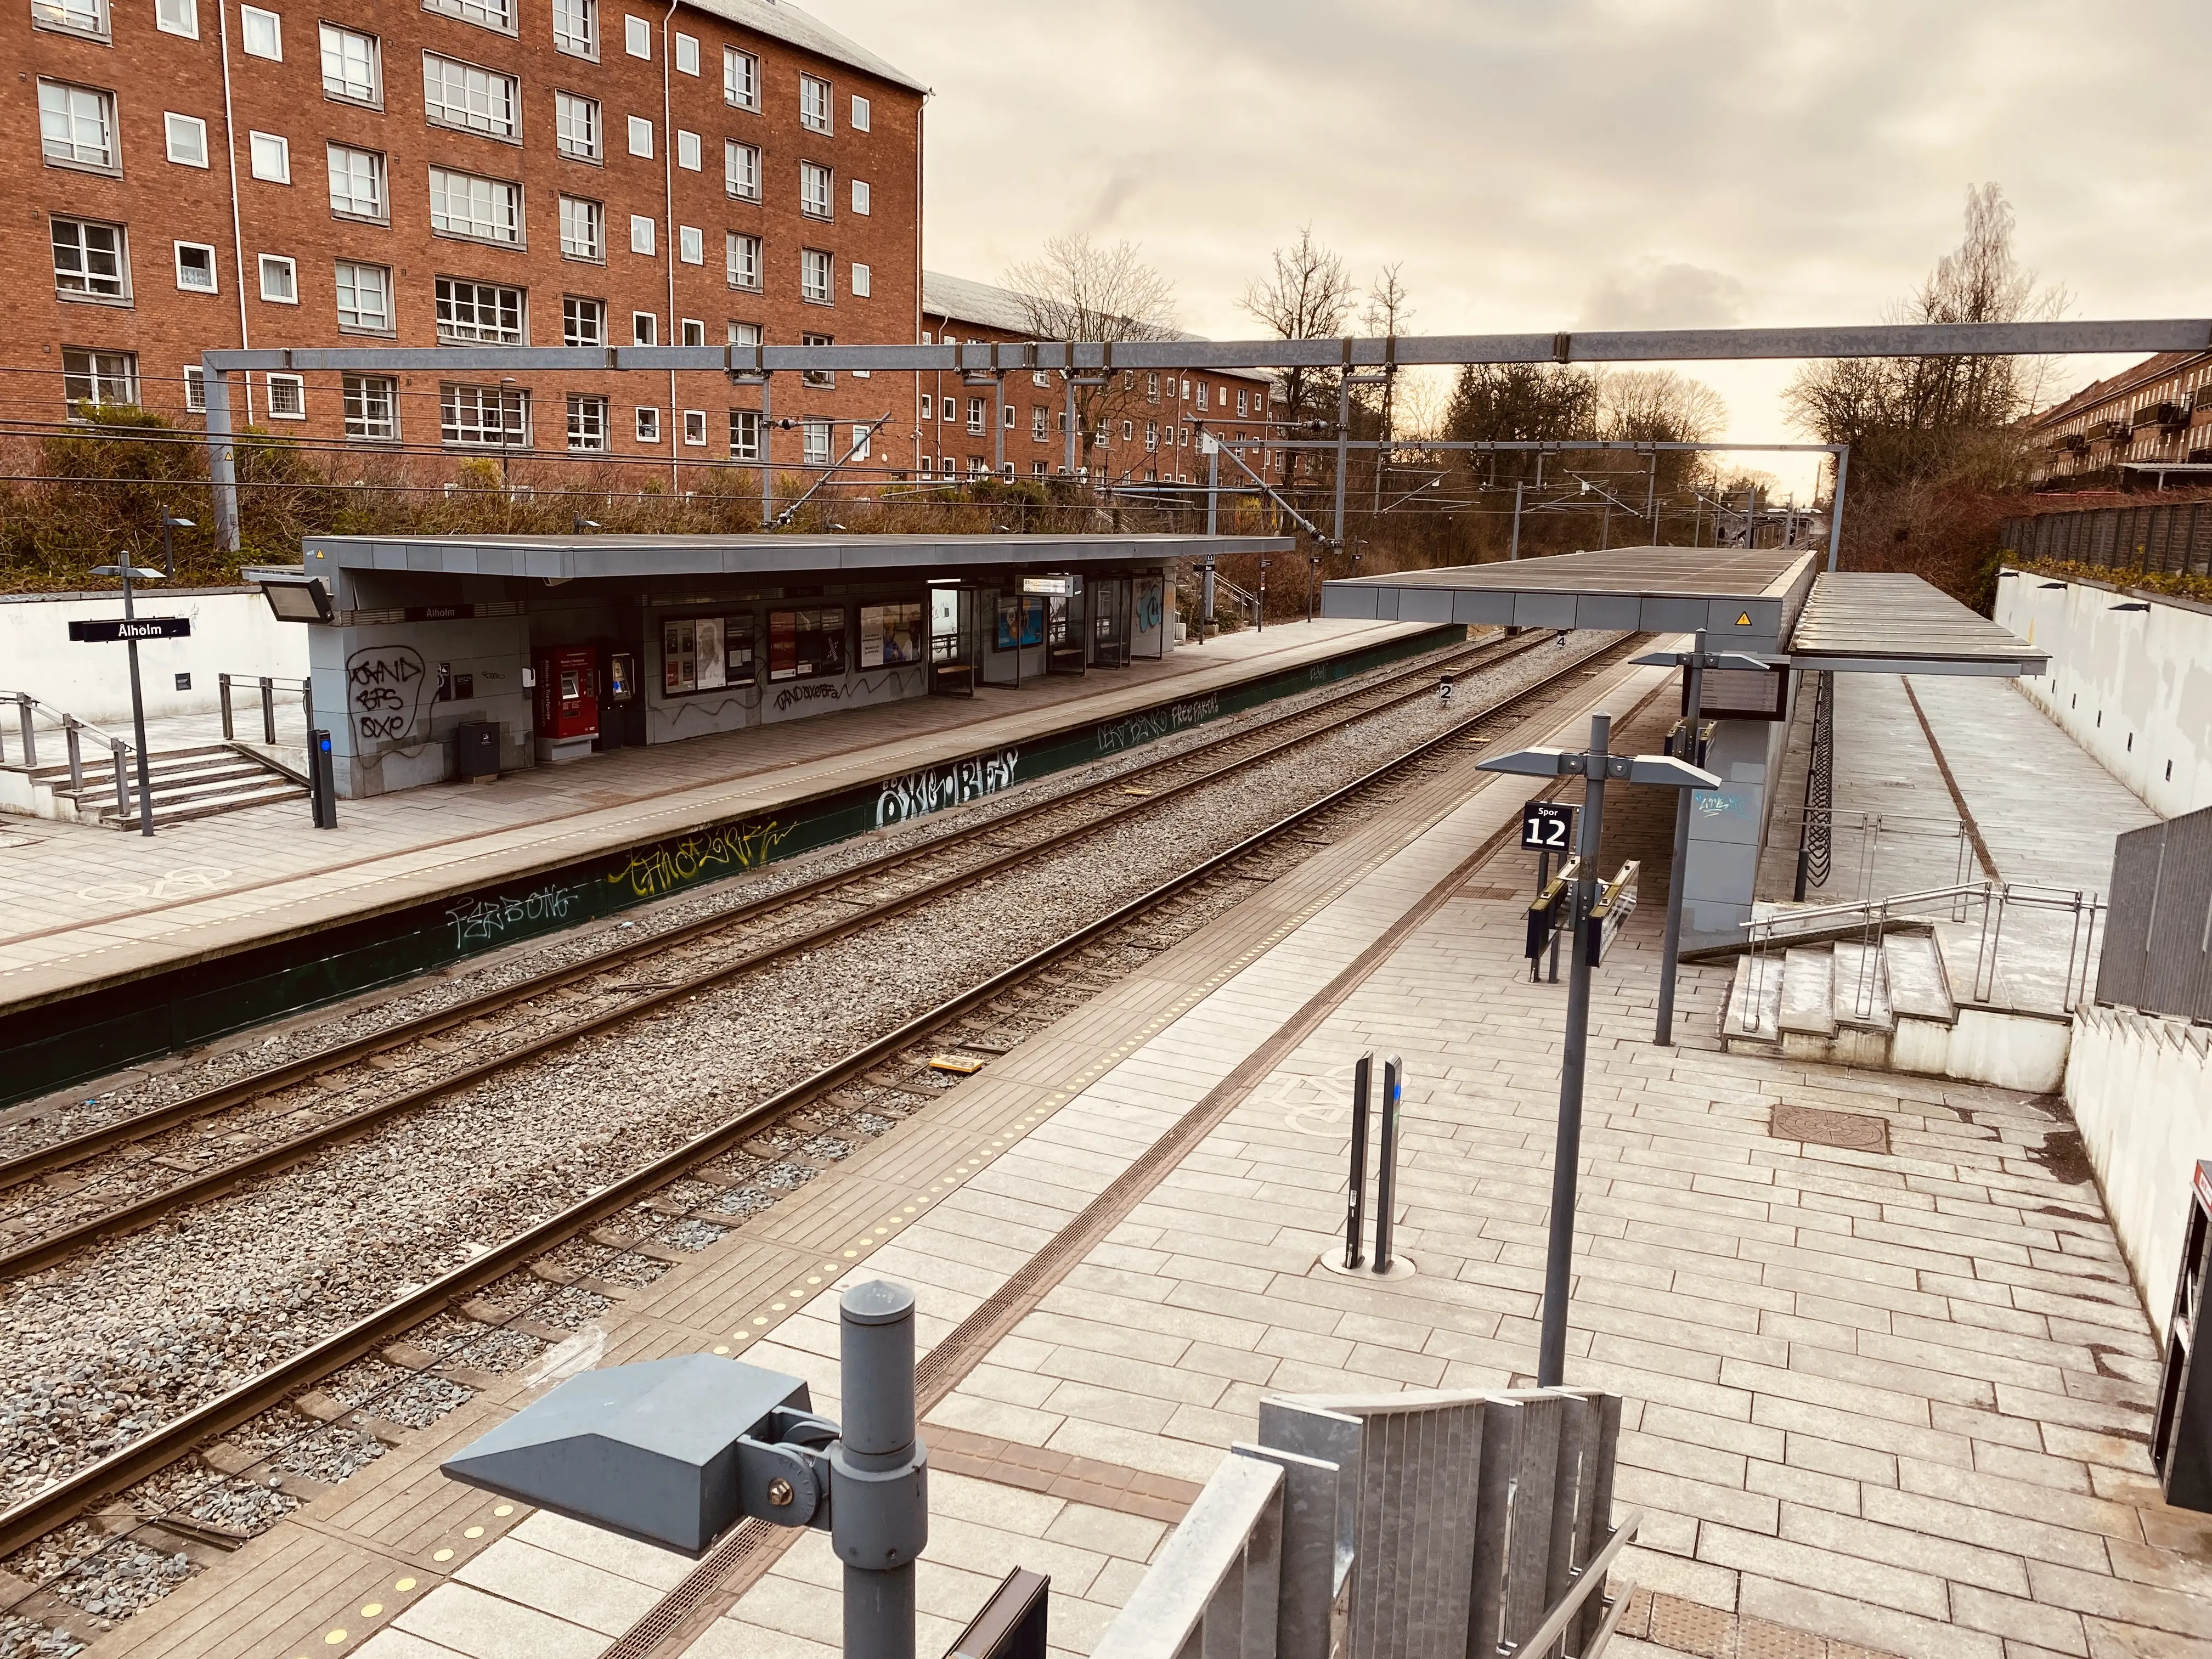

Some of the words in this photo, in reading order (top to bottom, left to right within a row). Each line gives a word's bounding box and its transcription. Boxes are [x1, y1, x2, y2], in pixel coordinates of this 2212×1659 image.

[426, 607, 455, 618] Ålholm
[118, 623, 162, 637] Ålholm
[1557, 637, 1566, 647] 4
[1441, 685, 1451, 699] 2
[1538, 808, 1559, 816] Spor
[1526, 818, 1566, 847] 12
